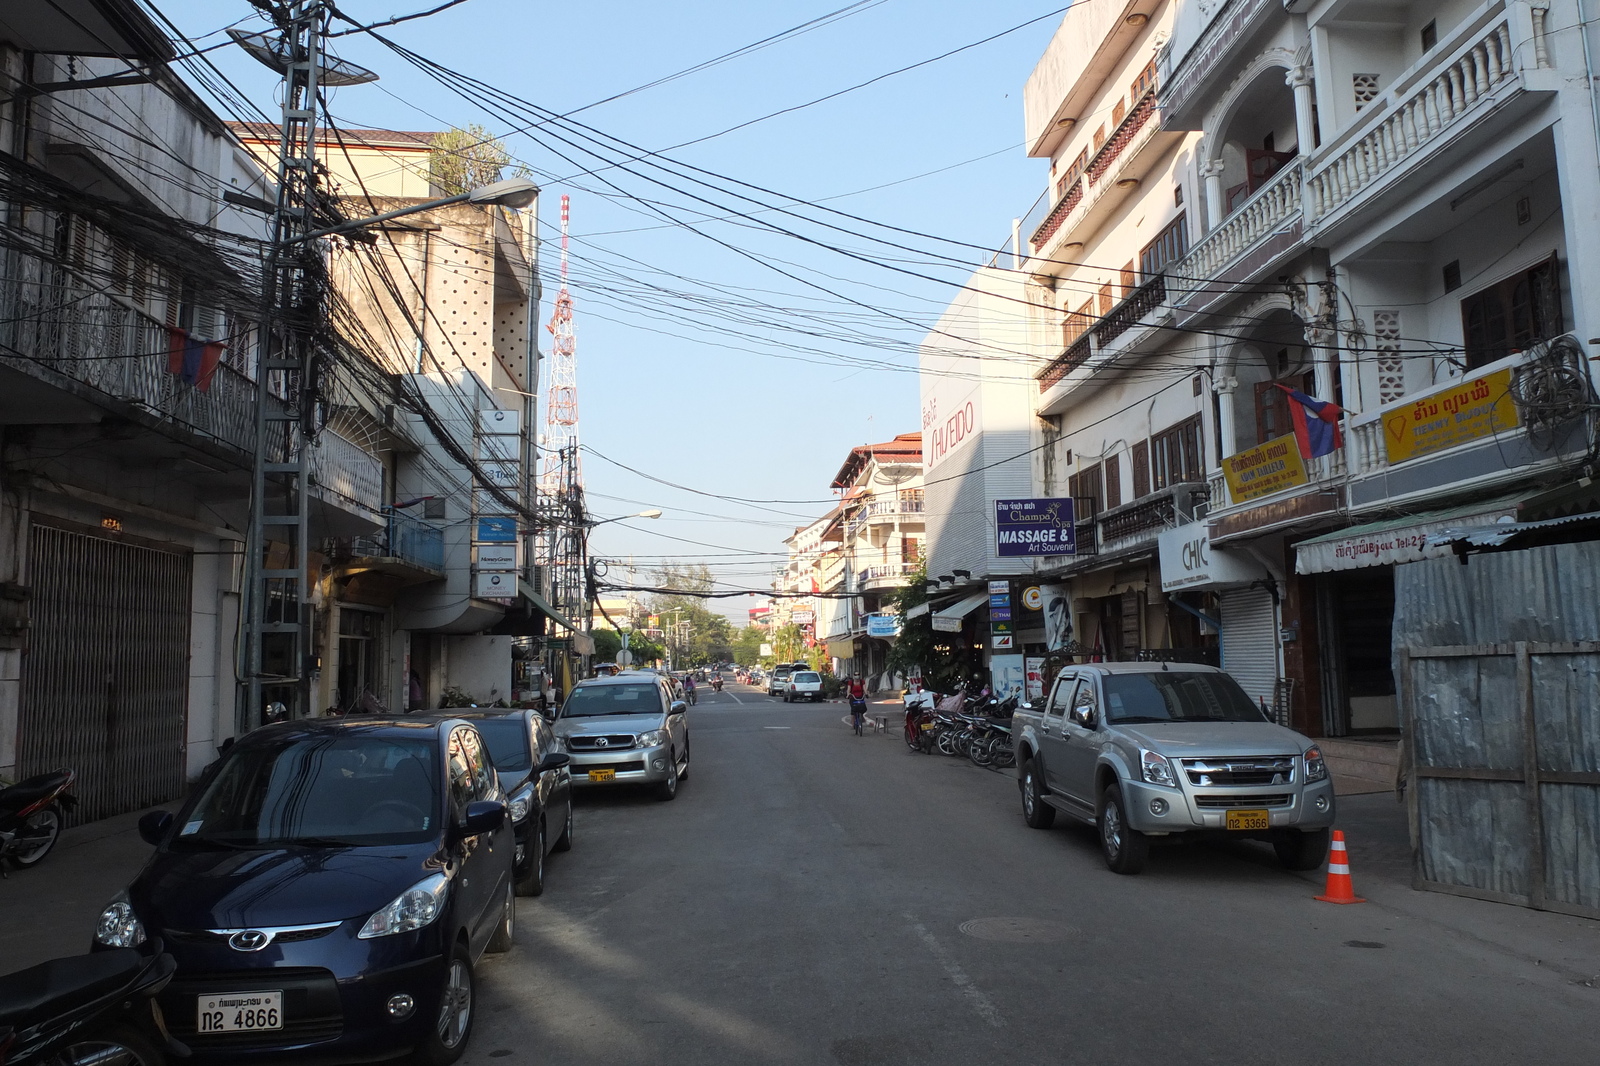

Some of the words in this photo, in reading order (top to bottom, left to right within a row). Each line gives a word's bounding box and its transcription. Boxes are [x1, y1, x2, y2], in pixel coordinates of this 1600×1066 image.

[1454, 401, 1497, 423] BIJOUX
[928, 401, 974, 468] SHISEIDO
[1241, 470, 1255, 482] ADAM
[1010, 510, 1050, 522] Champa
[1055, 517, 1071, 529] Spa
[999, 529, 1057, 544] MASSAGE
[1060, 529, 1068, 541] &
[1028, 543, 1040, 552] Art
[1042, 542, 1074, 552] Souvenir
[1182, 537, 1209, 571] CHIC
[1244, 818, 1267, 829] 3366
[234, 1007, 278, 1029] 4866
